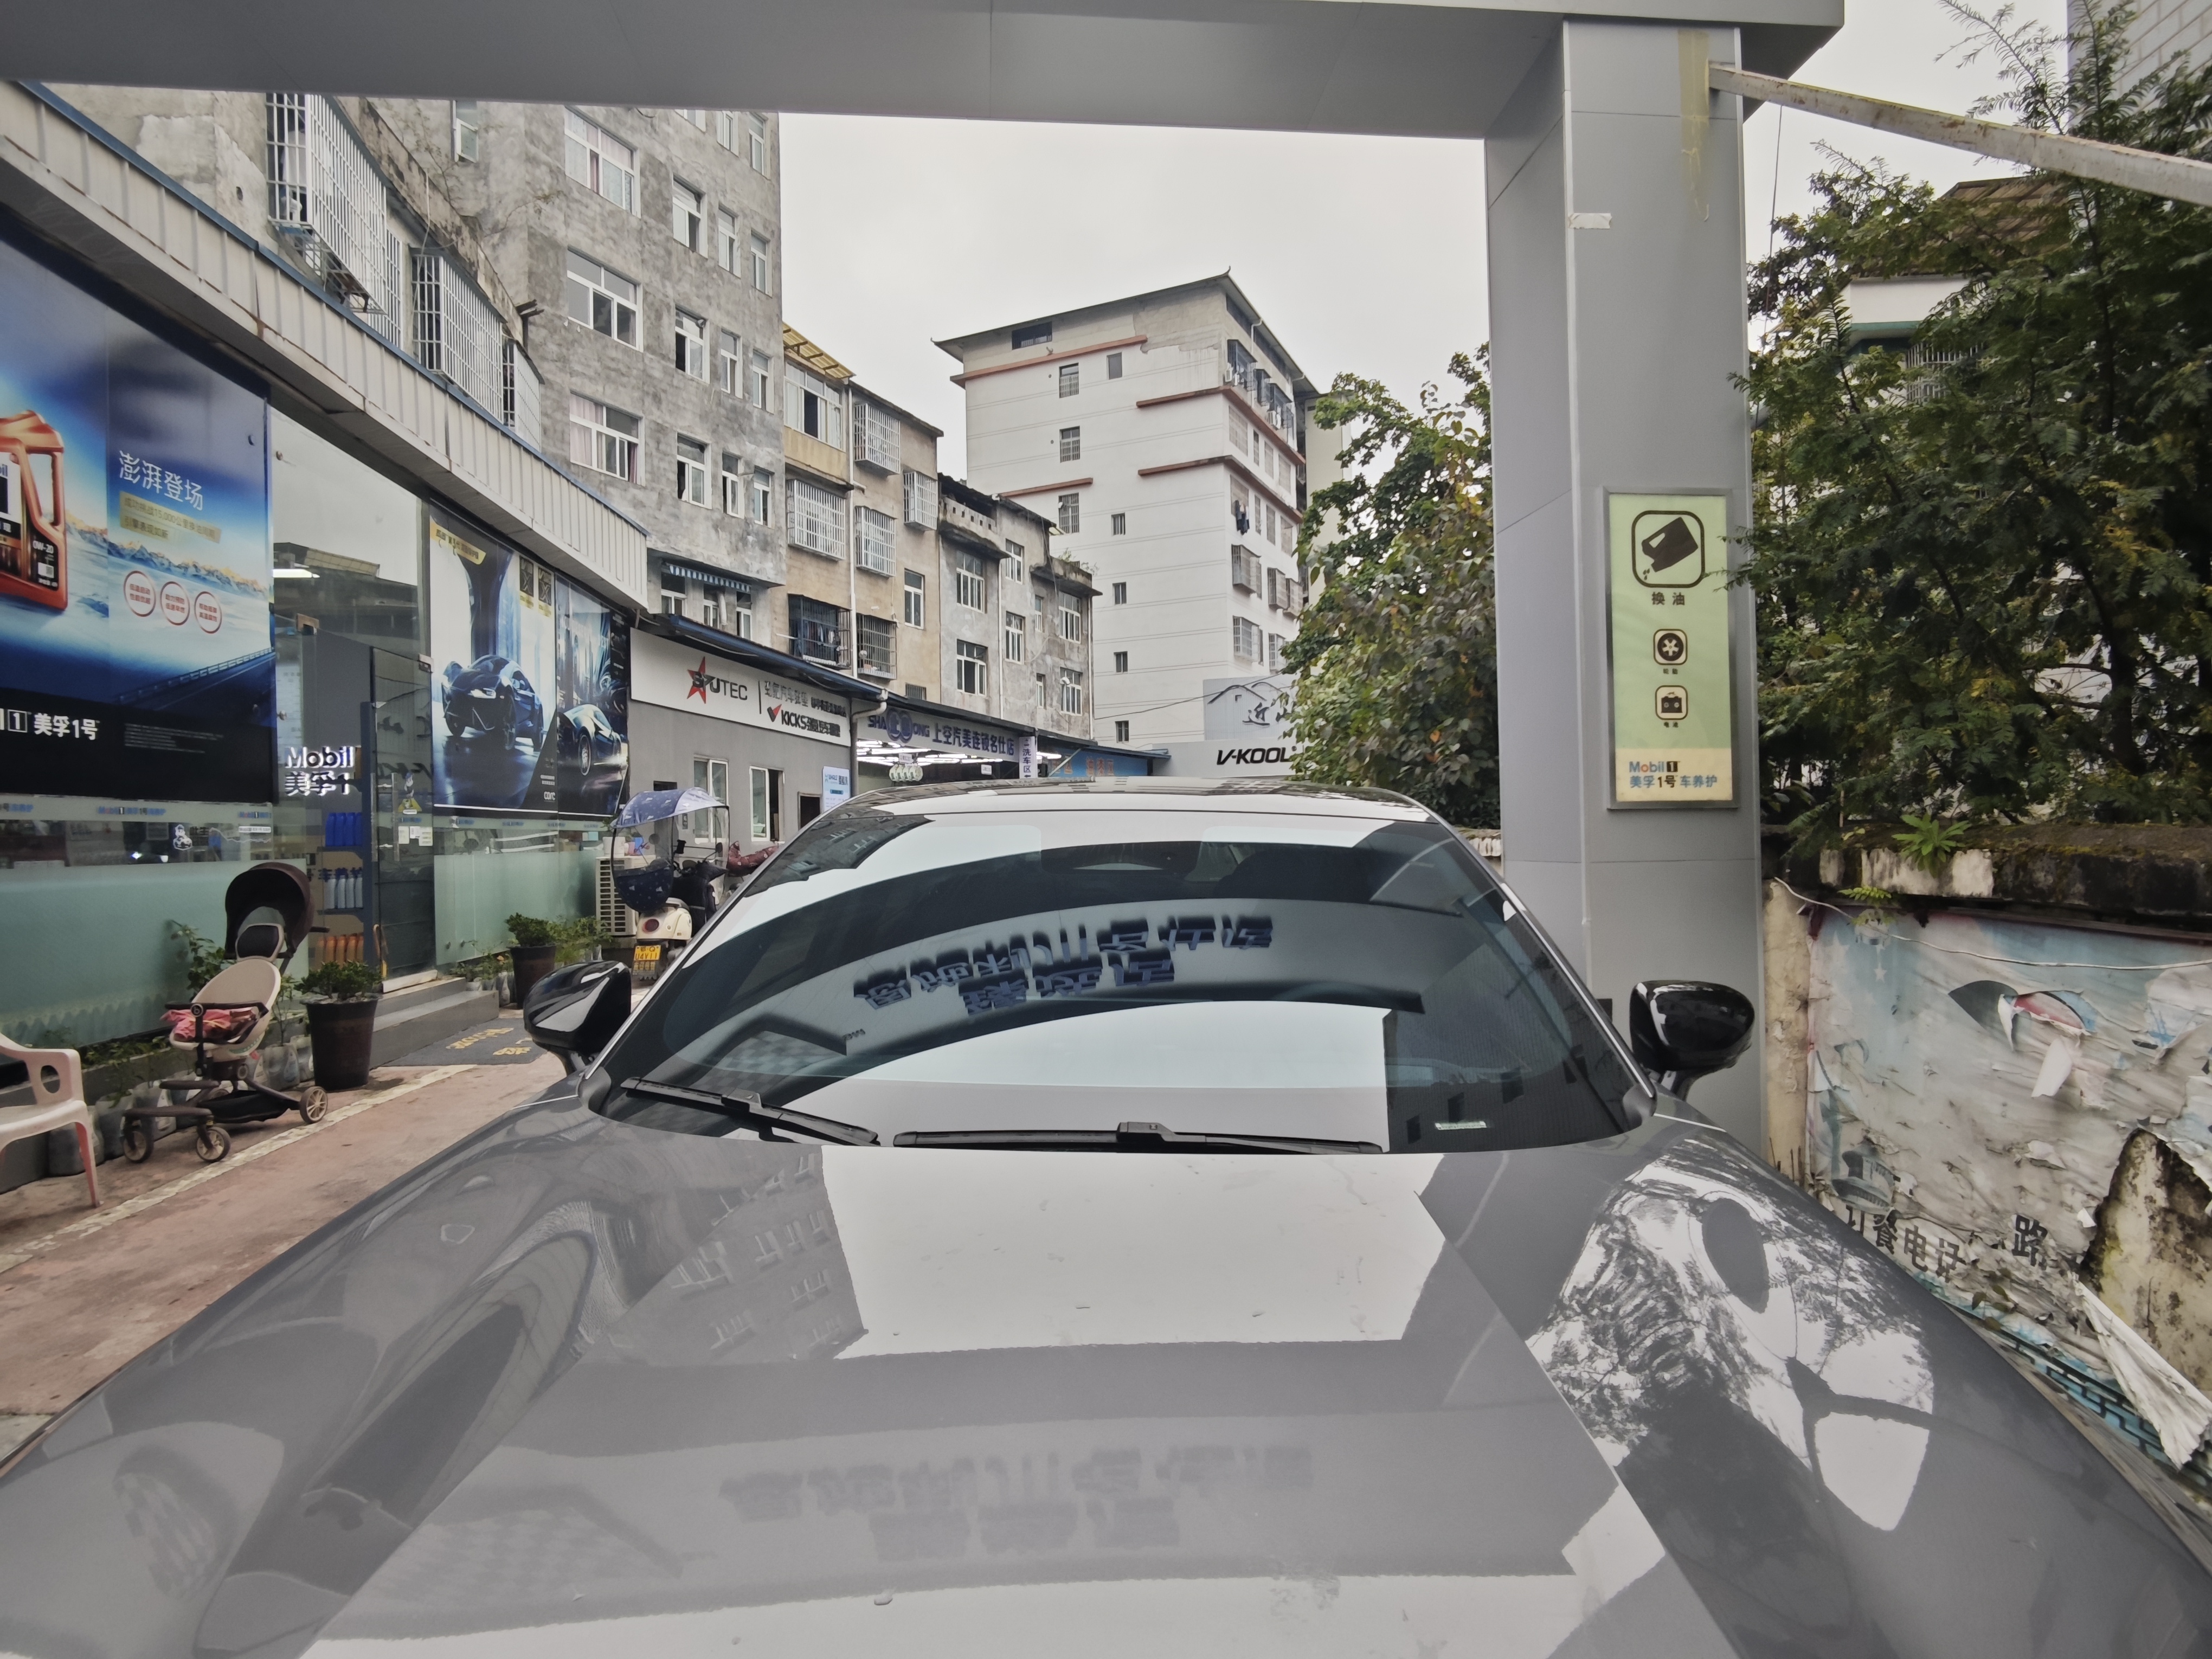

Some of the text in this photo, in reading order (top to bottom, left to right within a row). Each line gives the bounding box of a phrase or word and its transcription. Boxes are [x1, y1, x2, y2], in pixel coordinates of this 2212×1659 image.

[119, 450, 203, 511] 澎湃登场
[1652, 592, 1685, 606] 换油
[34, 713, 98, 740] 美孚1号
[781, 709, 807, 730] KICKS
[932, 723, 1014, 756] 上空汽美连锁名仕店
[285, 746, 355, 769] Mobil
[1023, 748, 1032, 773] 洗车区
[1217, 747, 1293, 766] V-KOOL
[1629, 761, 1664, 773] Mobil
